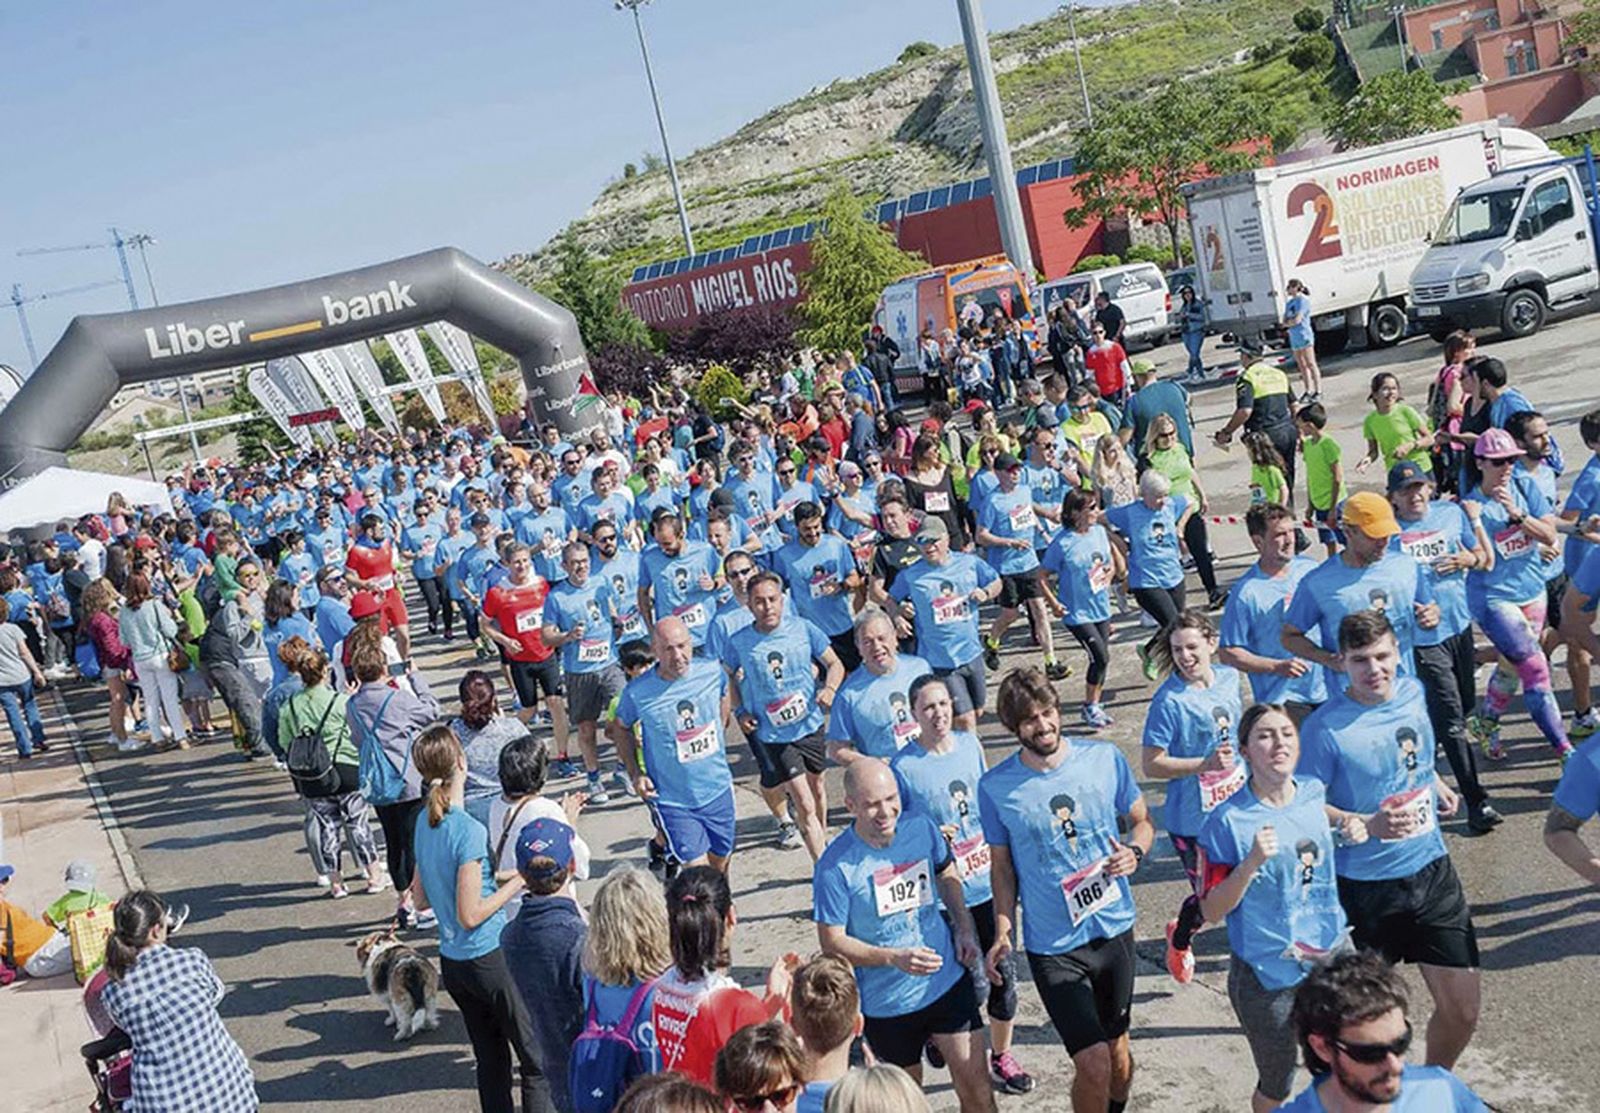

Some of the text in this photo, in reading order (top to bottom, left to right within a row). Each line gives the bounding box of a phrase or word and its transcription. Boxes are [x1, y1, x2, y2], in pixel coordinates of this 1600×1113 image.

[1336, 156, 1440, 191] NORIMAGEN
[1343, 193, 1446, 234] INTEGRALES
[691, 269, 753, 315] MIGUEL
[144, 280, 417, 360] Liber bank
[889, 880, 915, 903] 192
[1073, 881, 1103, 909] 186
